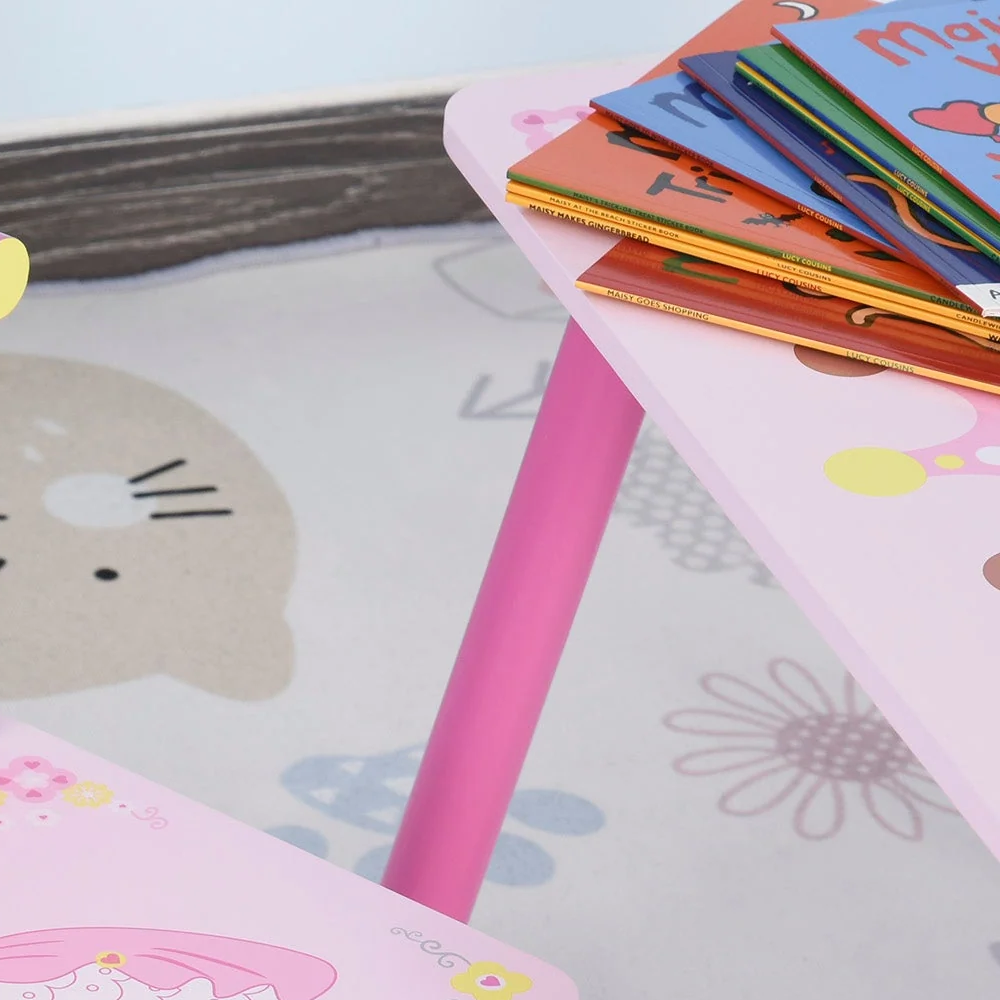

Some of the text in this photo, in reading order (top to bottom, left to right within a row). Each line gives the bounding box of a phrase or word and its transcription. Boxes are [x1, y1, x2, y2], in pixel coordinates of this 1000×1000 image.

[894, 168, 929, 198] LUCY COUSINS
[896, 185, 931, 213] LUCY COUSINS
[529, 203, 649, 244] MAISY MAKES GINGERBREAD
[549, 196, 679, 239] MAISY AT THE BEACH STICKER BOOK
[797, 203, 843, 231] LUCY COUSINS
[777, 261, 831, 282] LUCY COUSINS
[782, 251, 831, 272] LUCY COUSINS
[756, 268, 780, 281] LUCY
[782, 275, 822, 292] COUSINS
[607, 288, 709, 322] MAISY GOES SHOPPING
[846, 349, 913, 373] LUCY COUSINS
